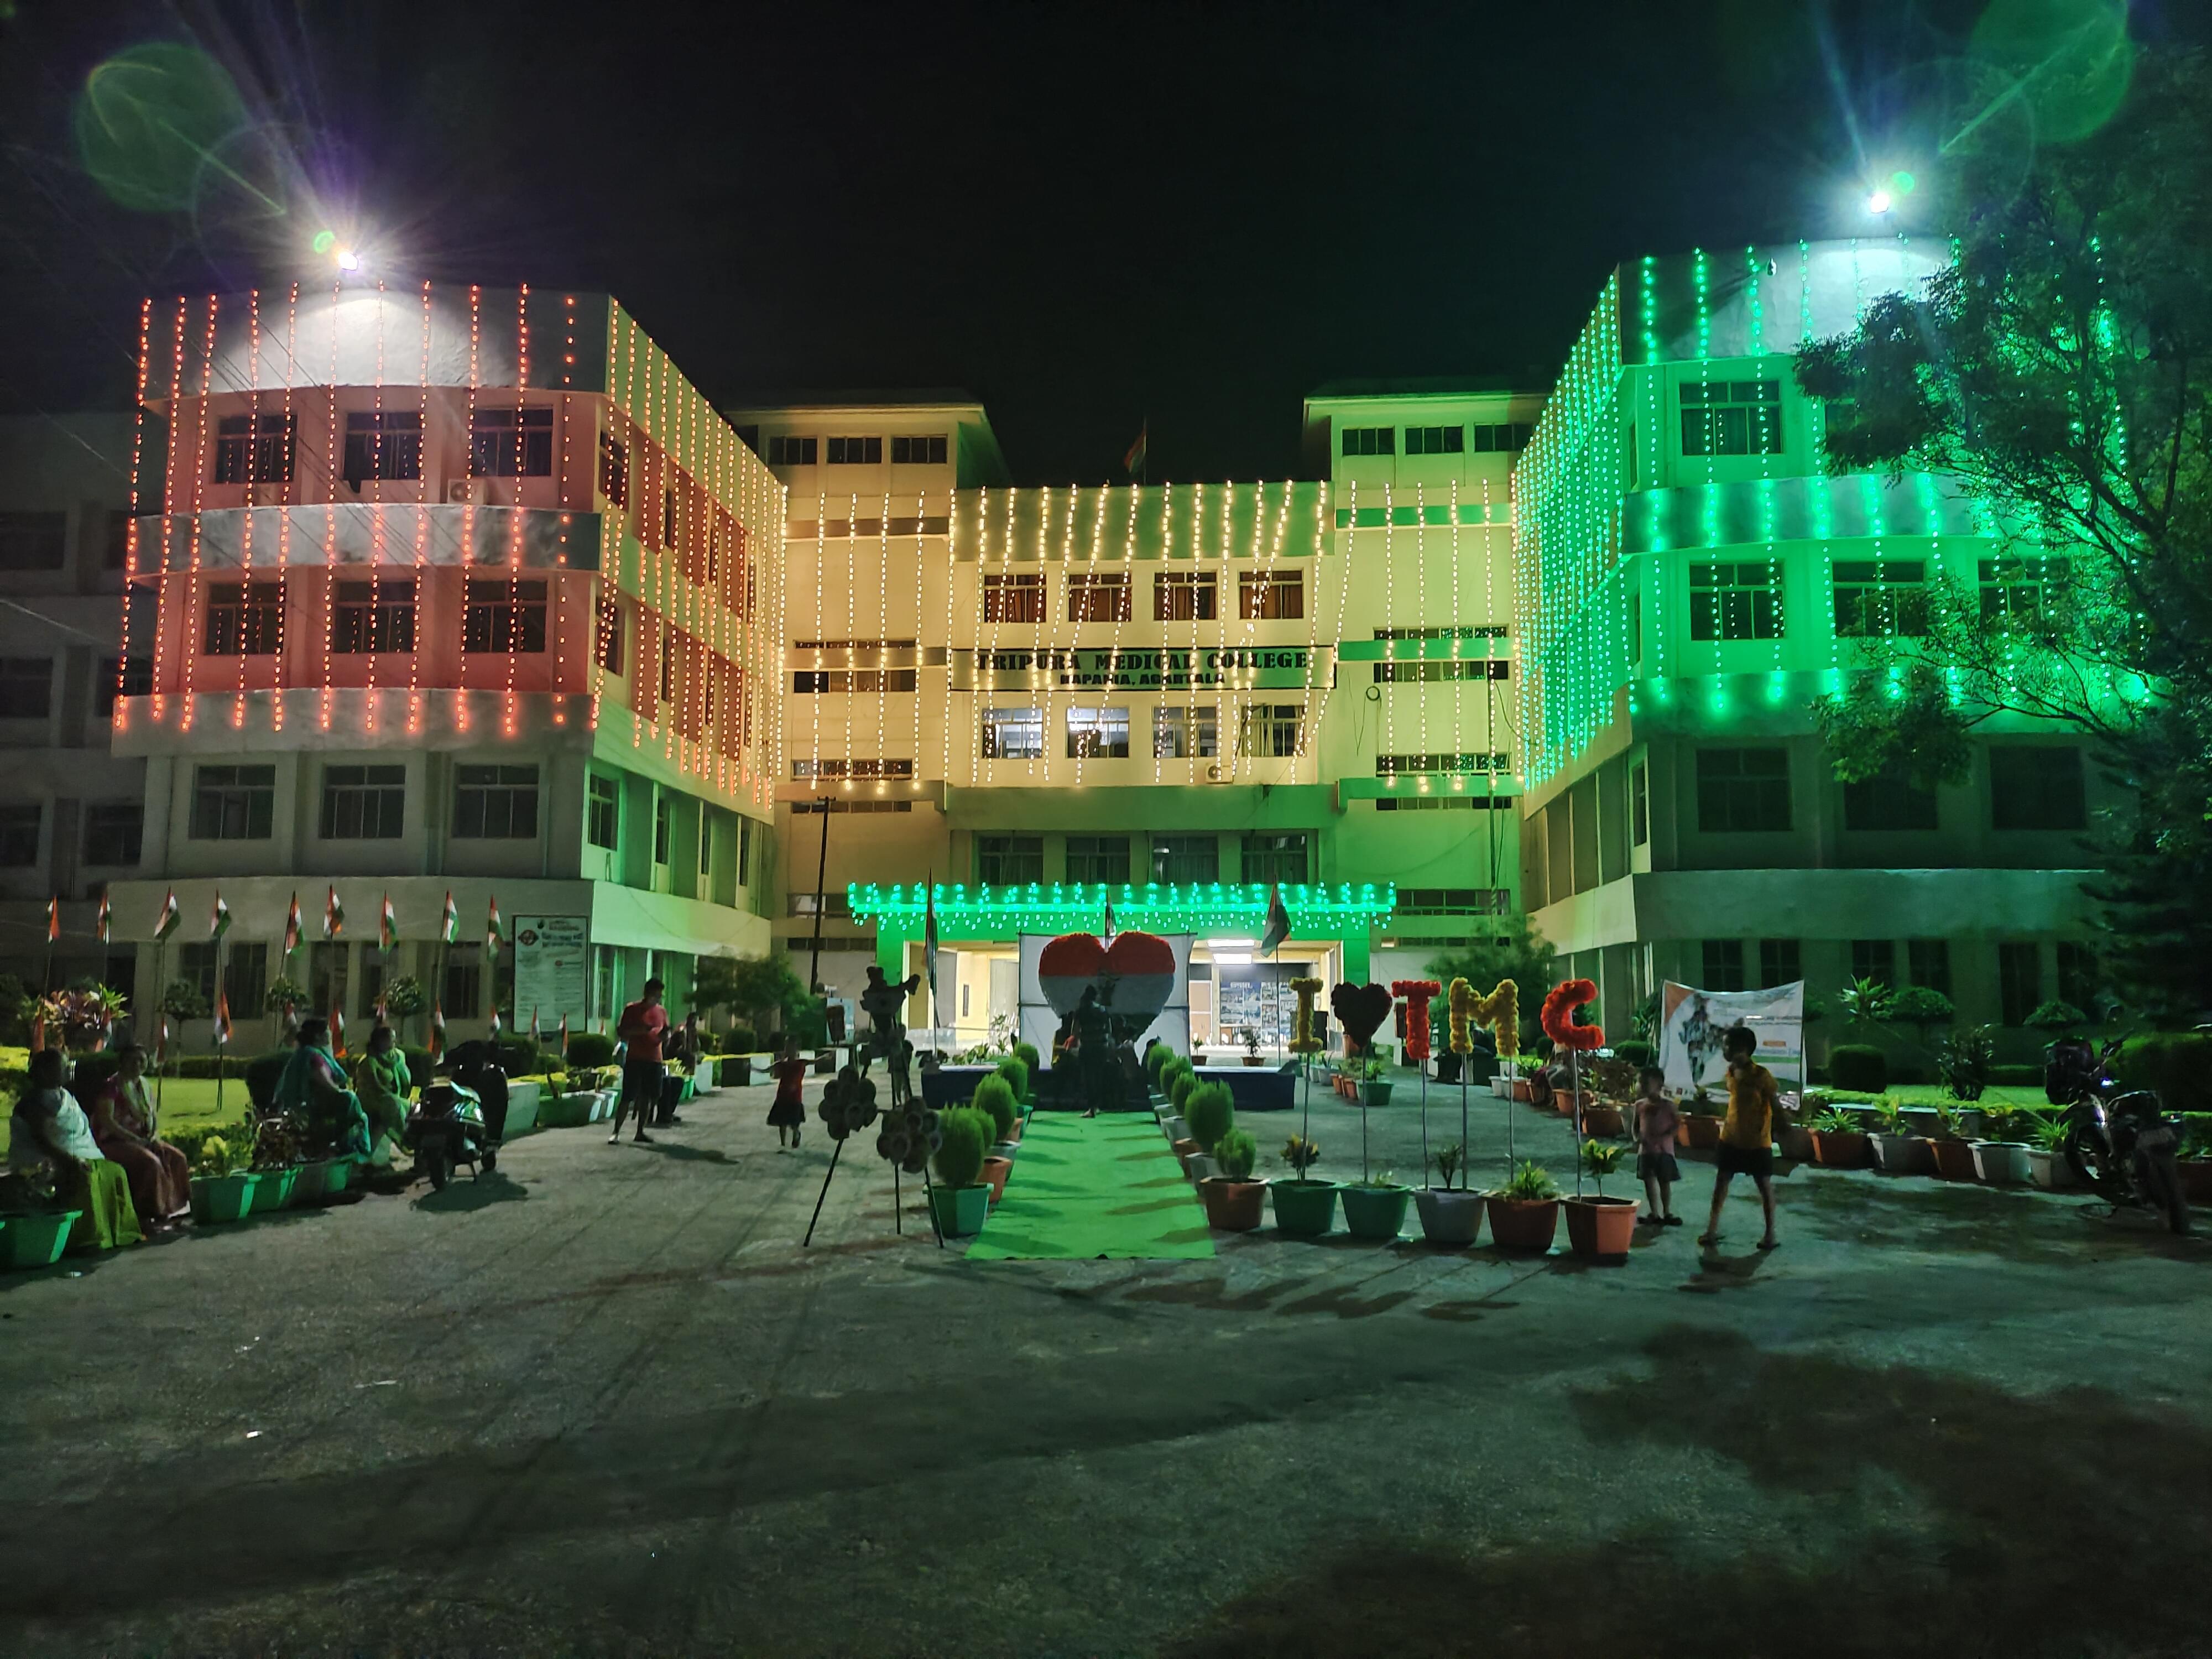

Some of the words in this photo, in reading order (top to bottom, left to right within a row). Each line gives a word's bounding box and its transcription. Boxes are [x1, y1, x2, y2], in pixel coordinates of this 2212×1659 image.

[978, 654, 1081, 670] TRIPURA
[1094, 654, 1195, 670] MEDICAL
[1207, 652, 1307, 669] COLLEGE
[1288, 977, 1324, 1053] I
